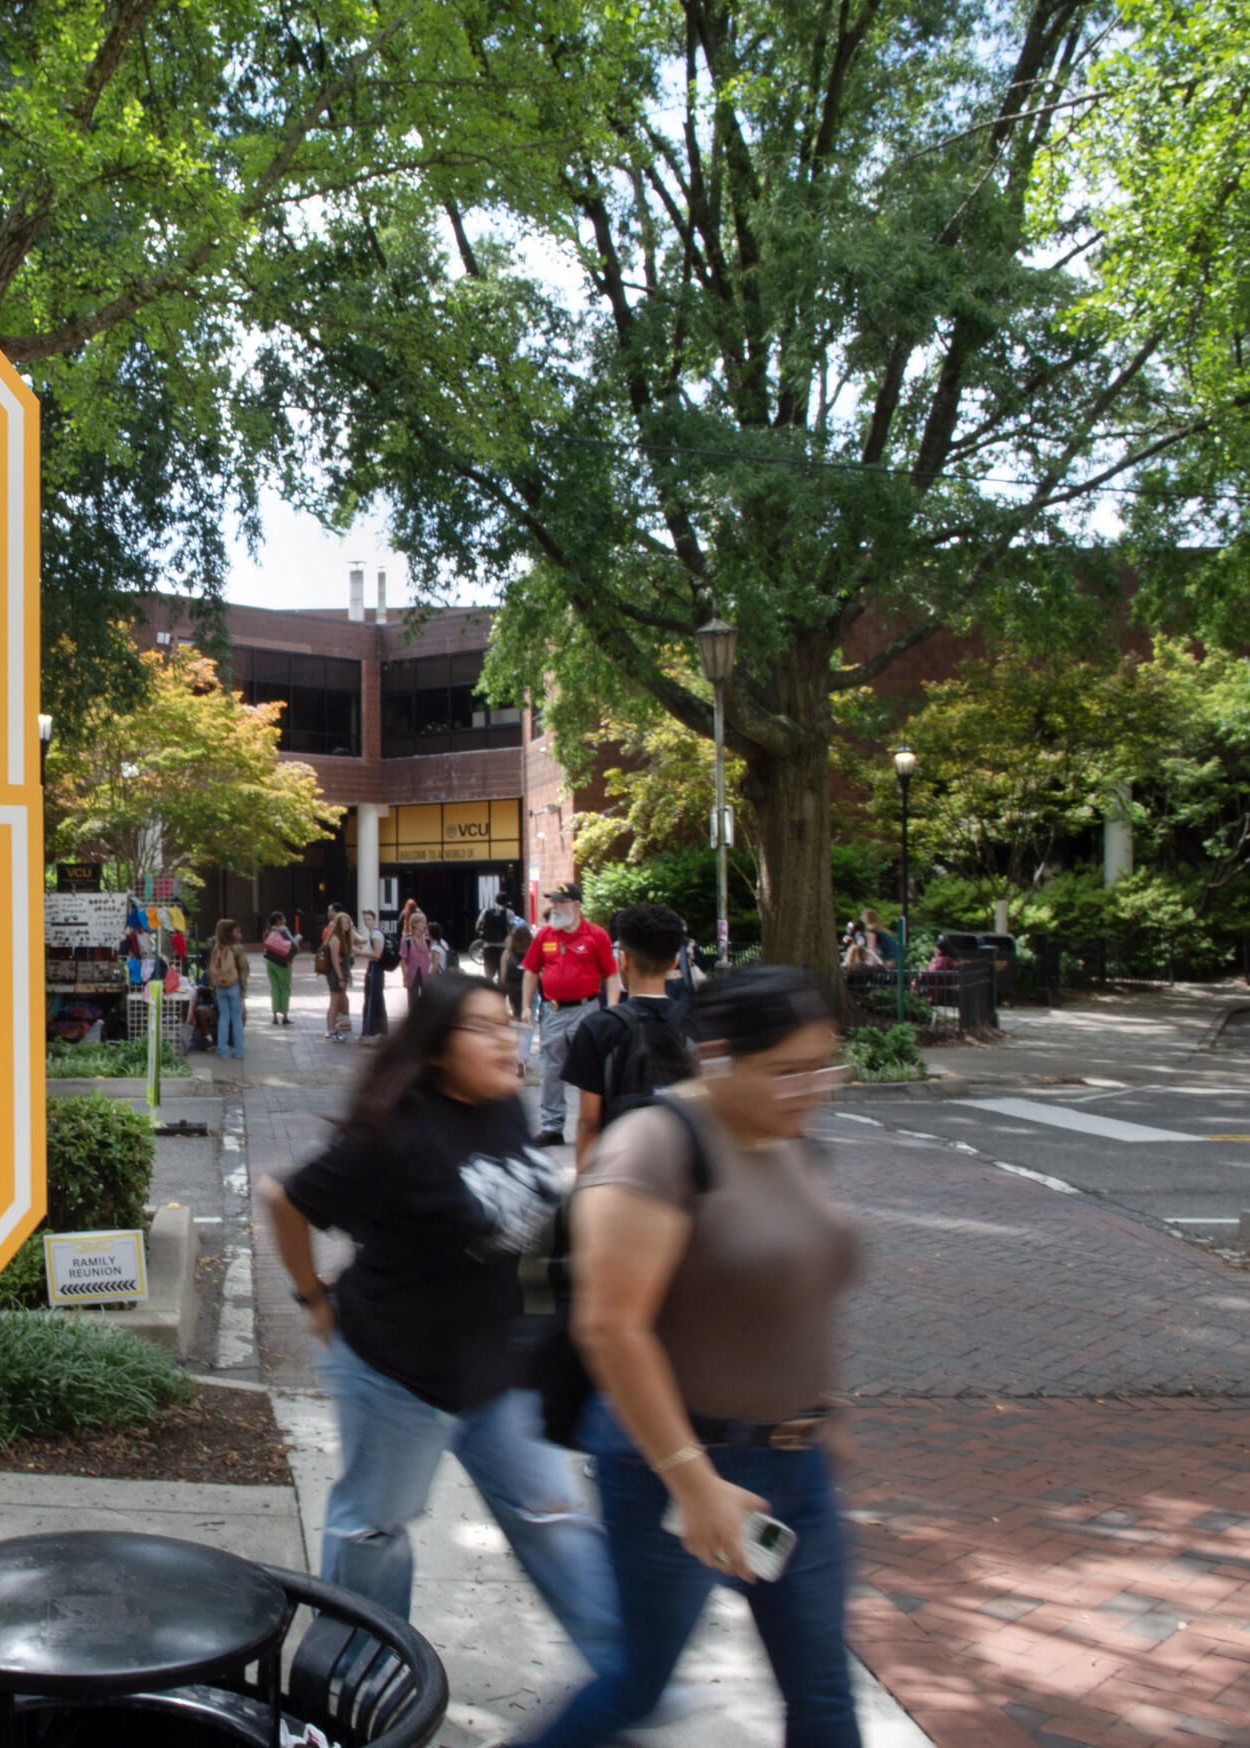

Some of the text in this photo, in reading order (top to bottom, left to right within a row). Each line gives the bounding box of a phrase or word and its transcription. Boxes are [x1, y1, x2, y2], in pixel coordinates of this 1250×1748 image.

[458, 823, 489, 837] VCU
[66, 868, 92, 878] VCU
[72, 1256, 116, 1268] RAMILY
[69, 1266, 122, 1278] REUNION
